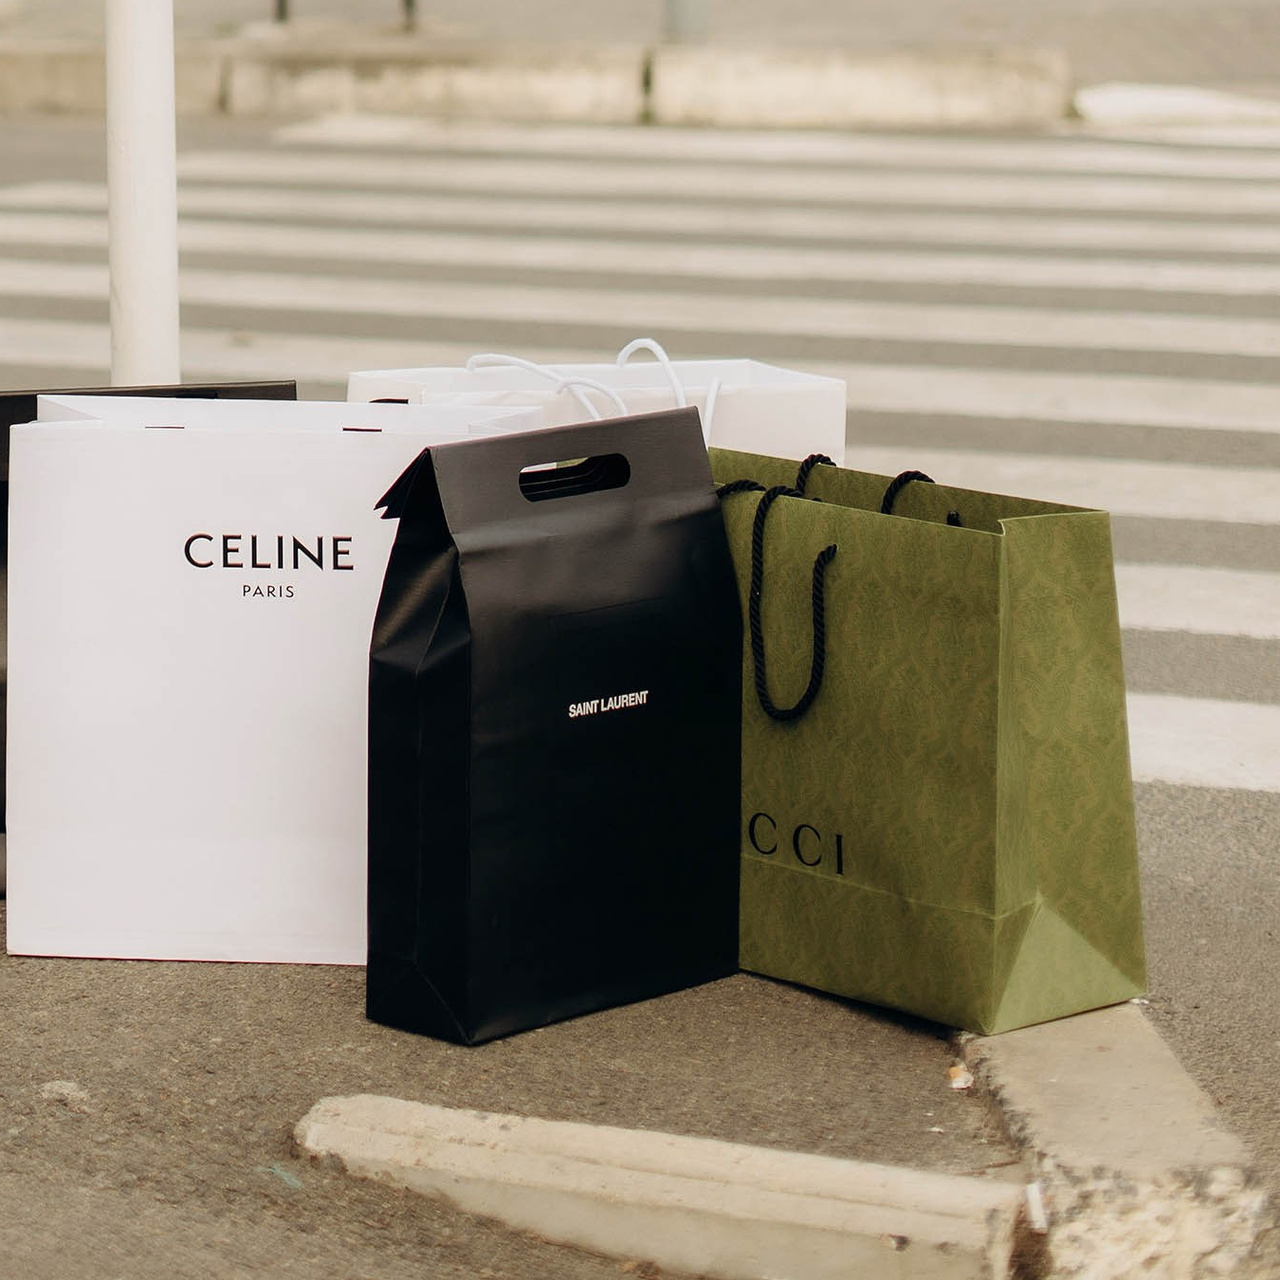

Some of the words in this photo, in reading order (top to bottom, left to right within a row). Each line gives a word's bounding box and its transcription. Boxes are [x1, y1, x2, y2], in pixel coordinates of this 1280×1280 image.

[184, 532, 355, 571] CELINE
[242, 584, 295, 599] PARIS
[568, 699, 600, 718] SAINT
[600, 690, 649, 712] LAURENT
